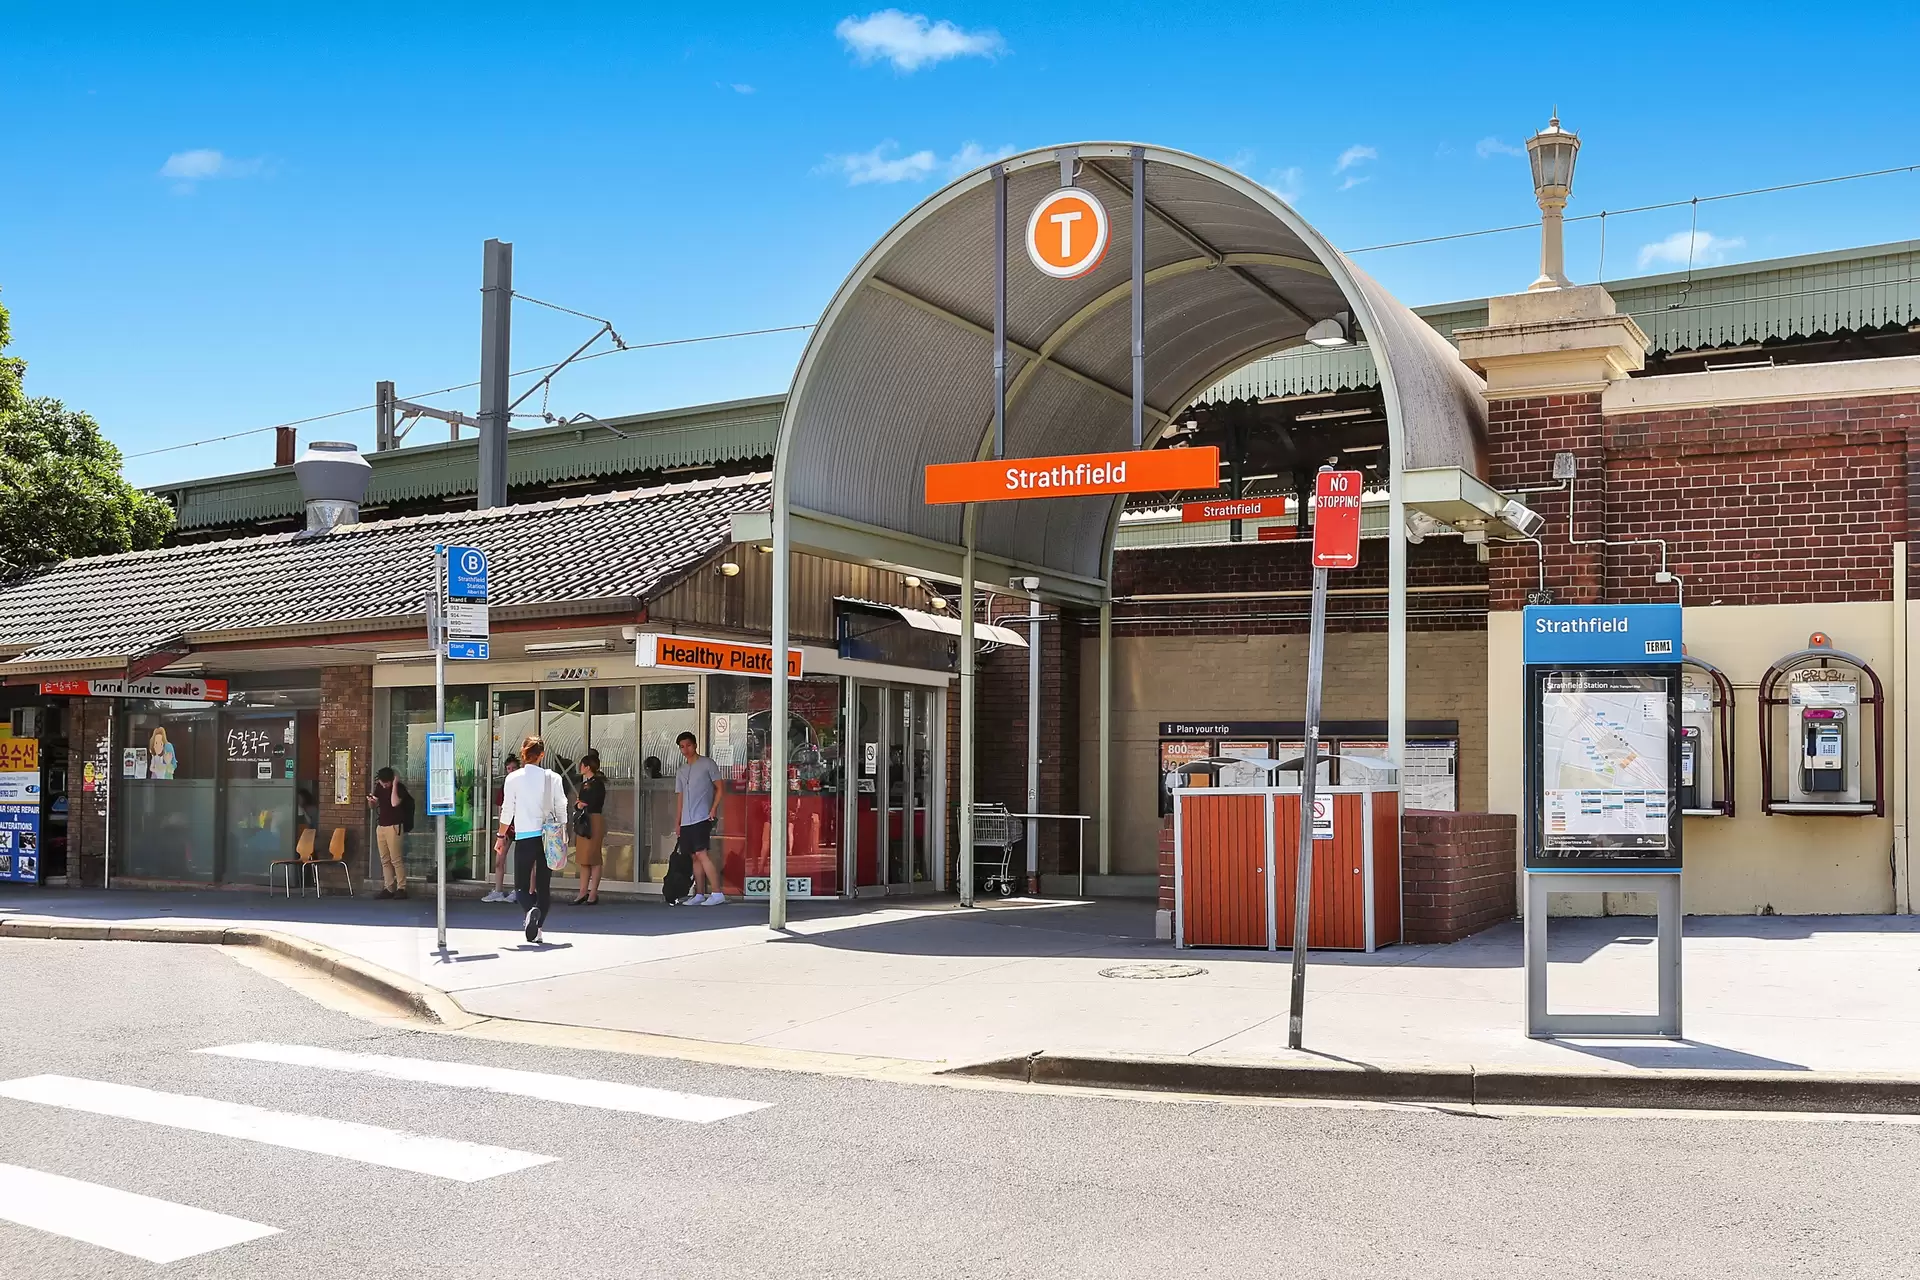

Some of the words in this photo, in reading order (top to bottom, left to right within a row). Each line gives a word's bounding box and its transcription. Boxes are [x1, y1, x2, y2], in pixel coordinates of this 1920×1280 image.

[1050, 211, 1082, 258] T
[1005, 461, 1126, 490] Strathfield
[1330, 477, 1349, 492] NO
[1317, 495, 1360, 508] STOPPING
[1203, 503, 1262, 517] Strathfield
[468, 556, 478, 570] B
[466, 582, 486, 590] Station
[1535, 617, 1628, 633] Strathfield
[478, 644, 486, 657] E
[1646, 641, 1671, 653] TERM1
[662, 643, 724, 670] Healthy
[730, 650, 796, 673] Platfom
[93, 680, 123, 694] hand
[127, 682, 161, 695] made
[165, 682, 200, 697] noodle
[1546, 681, 1583, 690] Strathfield
[1583, 681, 1609, 690] Station
[1176, 725, 1194, 733] Plan
[1195, 727, 1213, 735] your
[1214, 725, 1229, 735] trip
[227, 728, 270, 757] 손칼국수
[0, 743, 35, 769] 옷수선
[1167, 744, 1188, 755] 800
[6, 805, 20, 813] SHOE
[21, 806, 40, 814] REPAIR
[0, 822, 32, 830] ALTERATIONS
[747, 879, 808, 892] COEE
